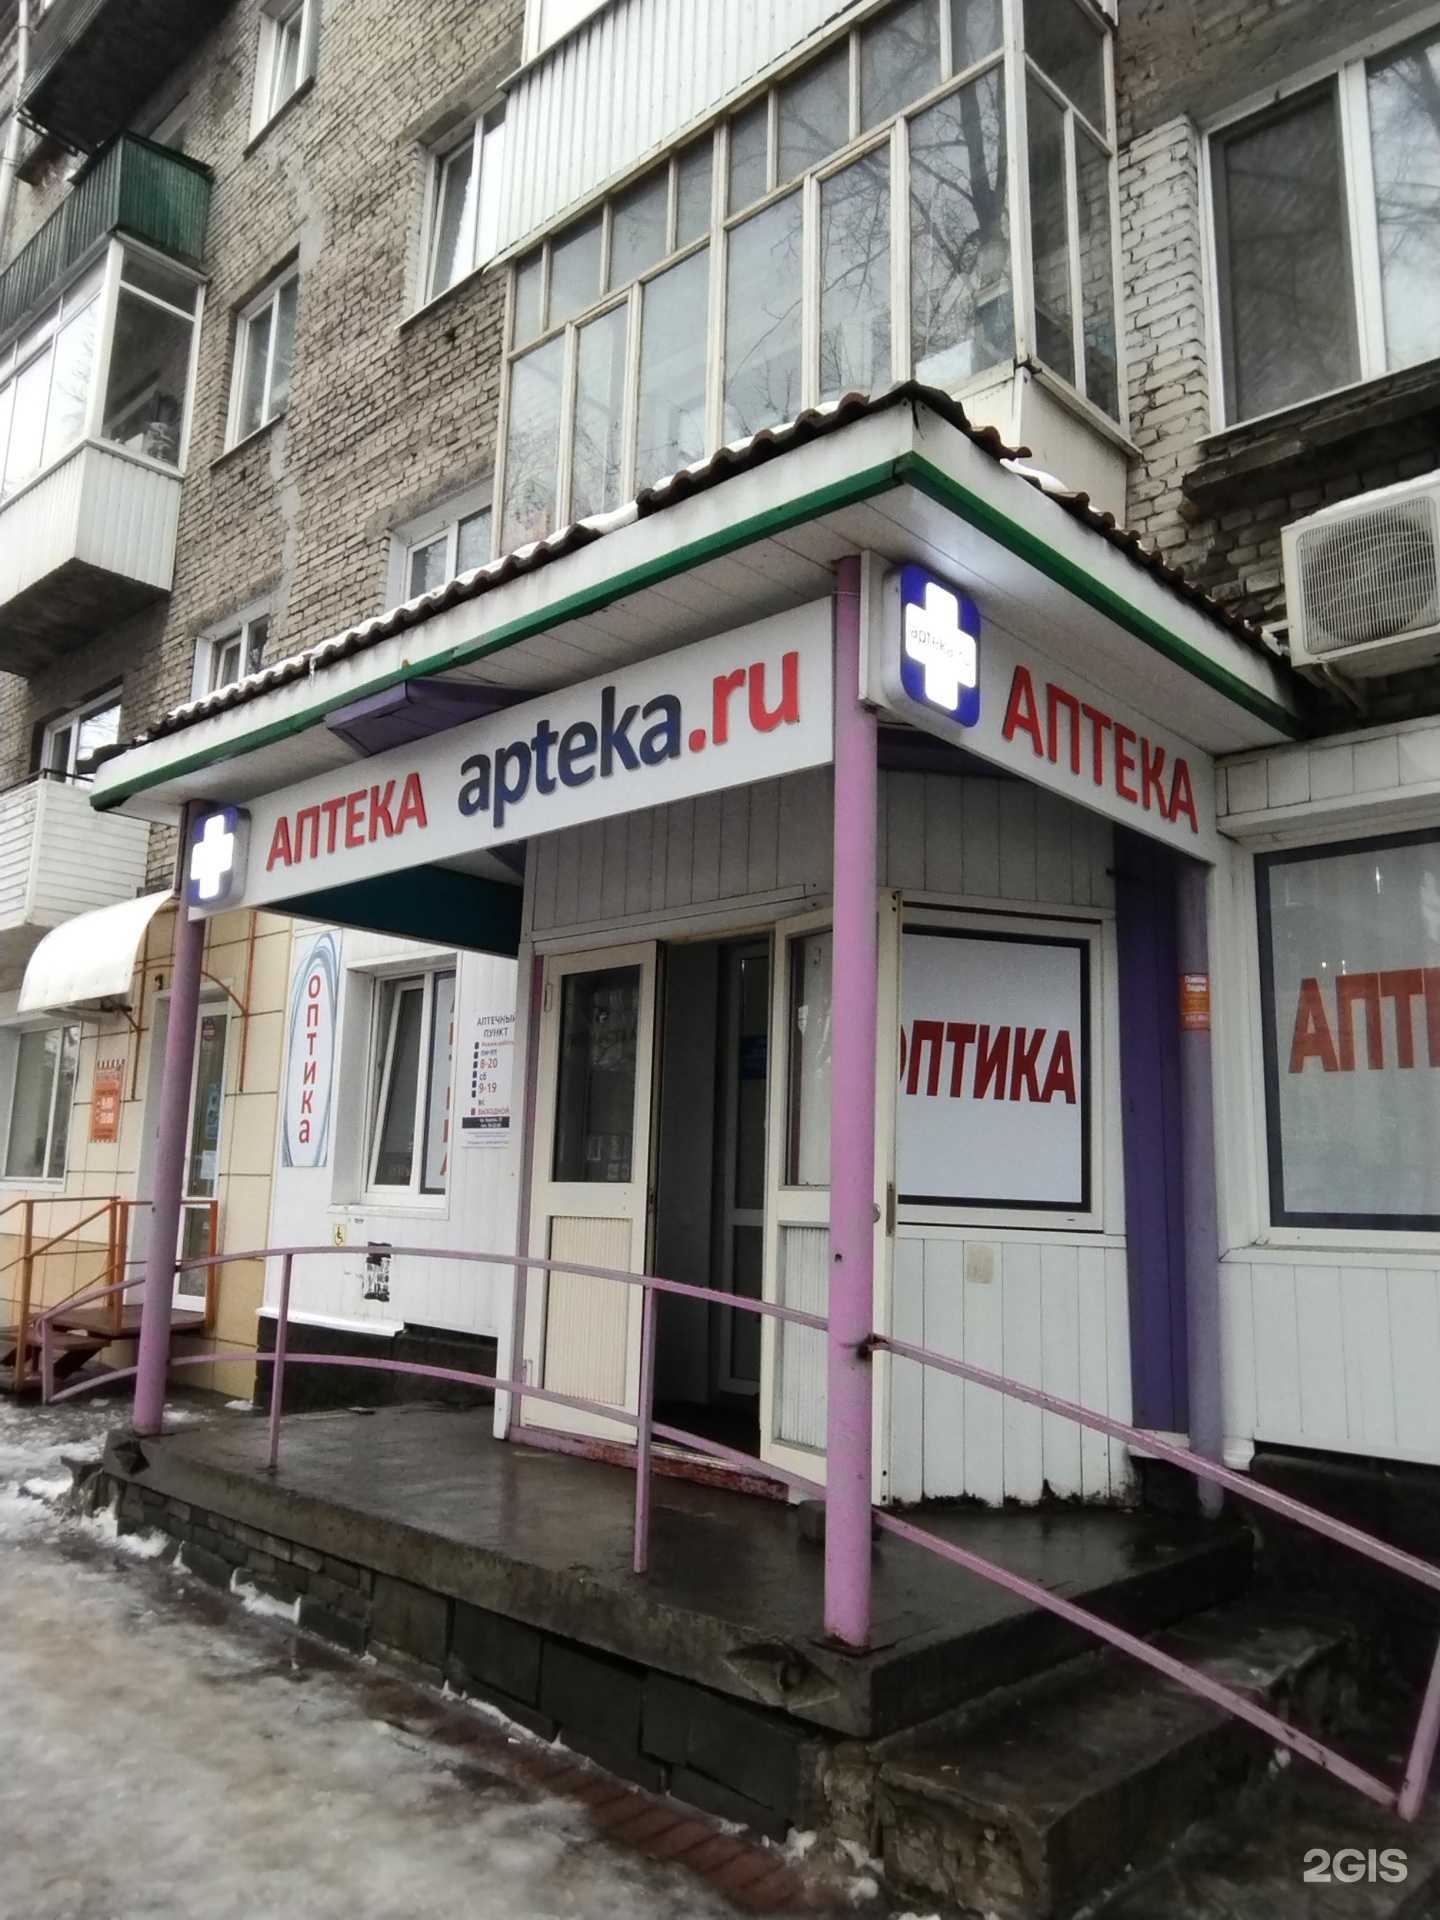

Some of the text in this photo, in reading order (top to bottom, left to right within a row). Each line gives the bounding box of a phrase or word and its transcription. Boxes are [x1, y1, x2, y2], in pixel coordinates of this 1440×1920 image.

[266, 651, 800, 872] АПТЕКА apteka.ru
[1001, 664, 1199, 834] АПТЕКА
[900, 1019, 1077, 1106] ПТИКА
